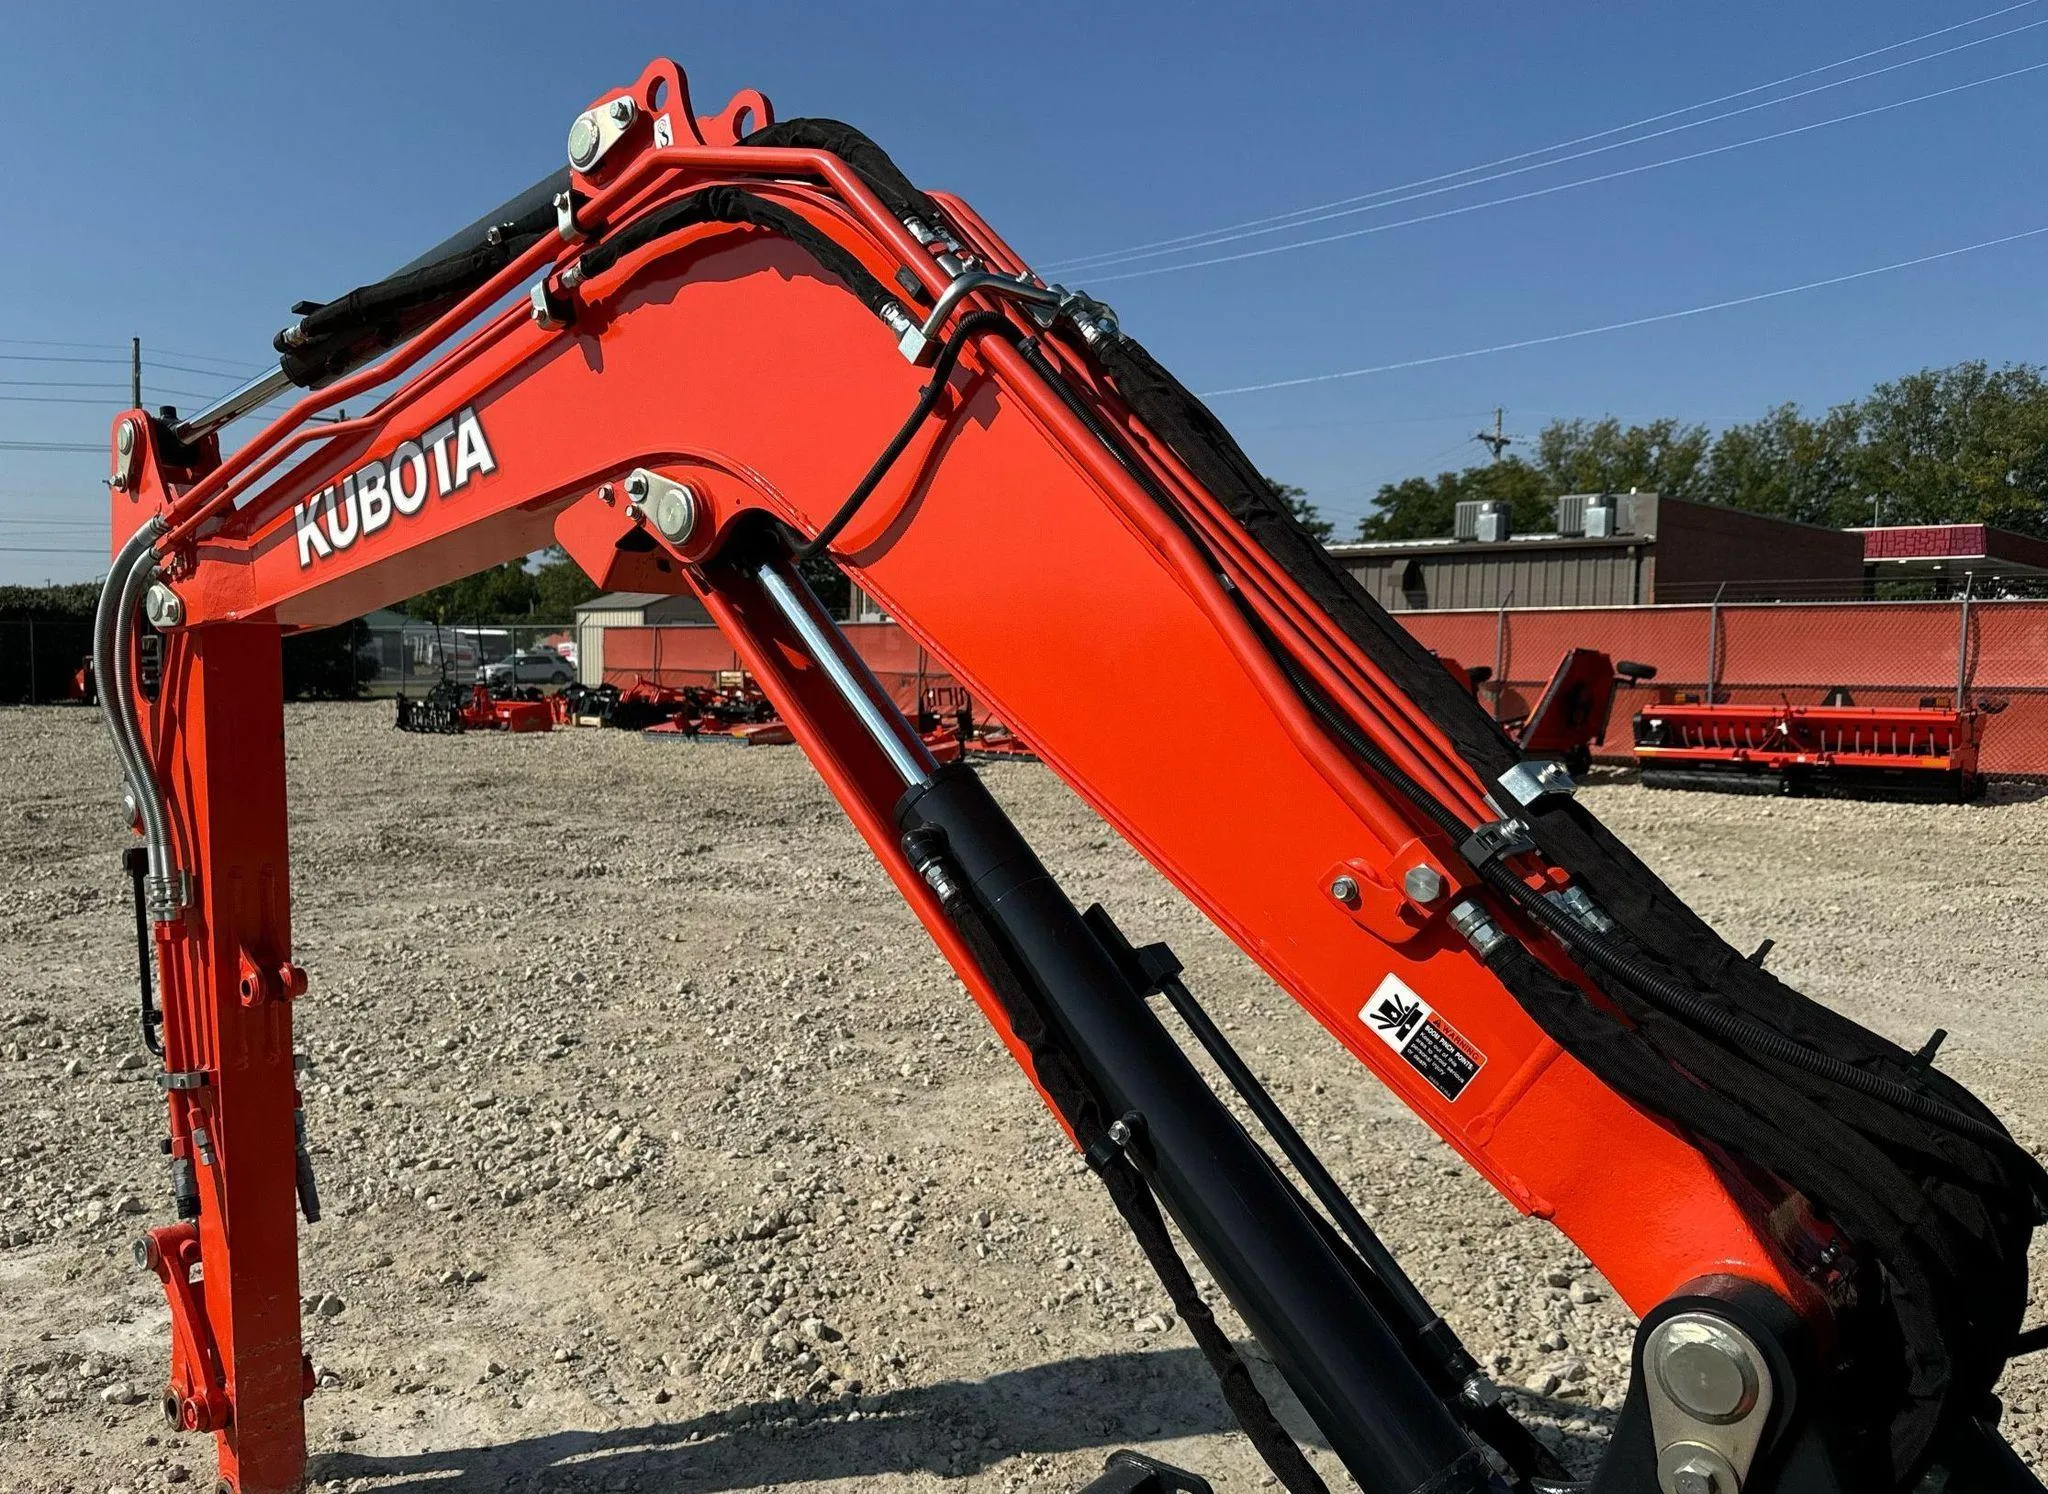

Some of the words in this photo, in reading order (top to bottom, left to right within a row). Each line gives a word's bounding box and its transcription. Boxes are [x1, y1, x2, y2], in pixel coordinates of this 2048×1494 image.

[293, 405, 496, 568] KUBOTA
[1419, 1031, 1433, 1046] Keep
[1433, 1044, 1442, 1053] out
[1448, 1057, 1457, 1067] this
[1424, 1024, 1440, 1040] BOOM
[1439, 1037, 1455, 1053] PINCH
[1442, 1025, 1480, 1060] WARNING
[1410, 1043, 1432, 1063] personal
[1431, 1061, 1446, 1076] injury
[1415, 1037, 1427, 1050] area
[1427, 1047, 1433, 1055] to
[1433, 1053, 1447, 1067] avoid
[1446, 1066, 1465, 1084] serious
